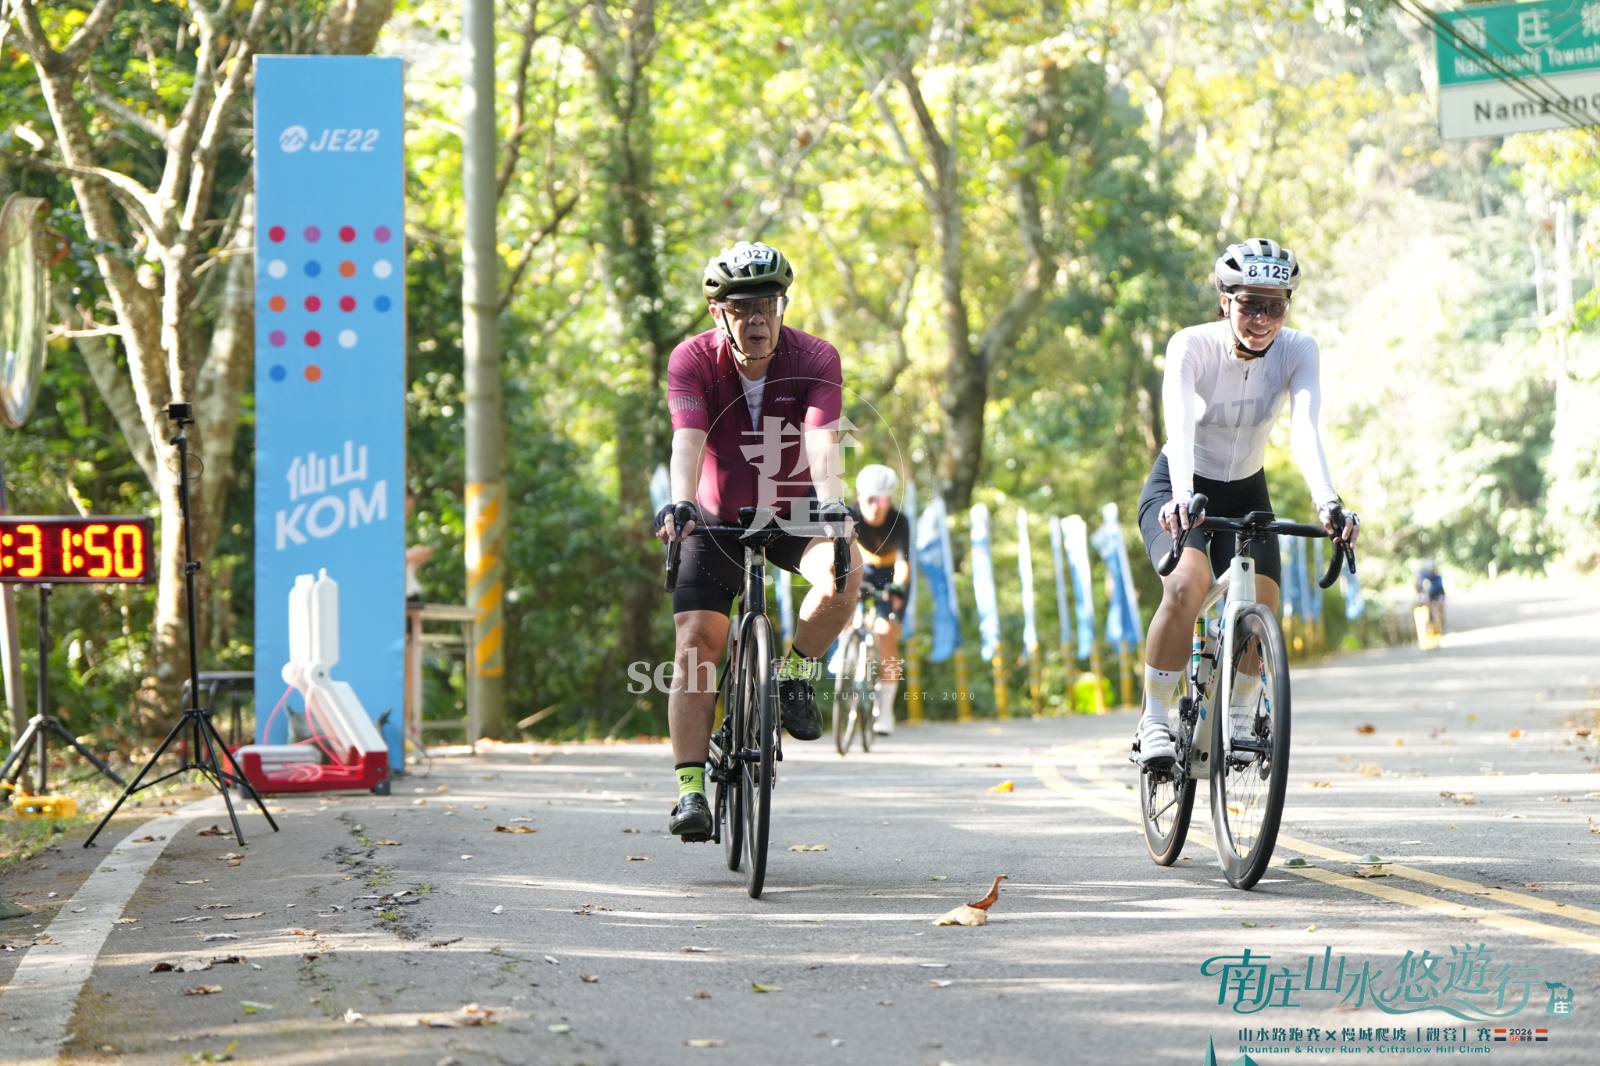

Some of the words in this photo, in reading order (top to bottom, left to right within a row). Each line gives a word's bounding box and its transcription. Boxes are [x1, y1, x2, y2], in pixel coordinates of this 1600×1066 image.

[309, 128, 380, 152] JE22
[286, 440, 367, 501] 仙山
[275, 479, 387, 551] KOM
